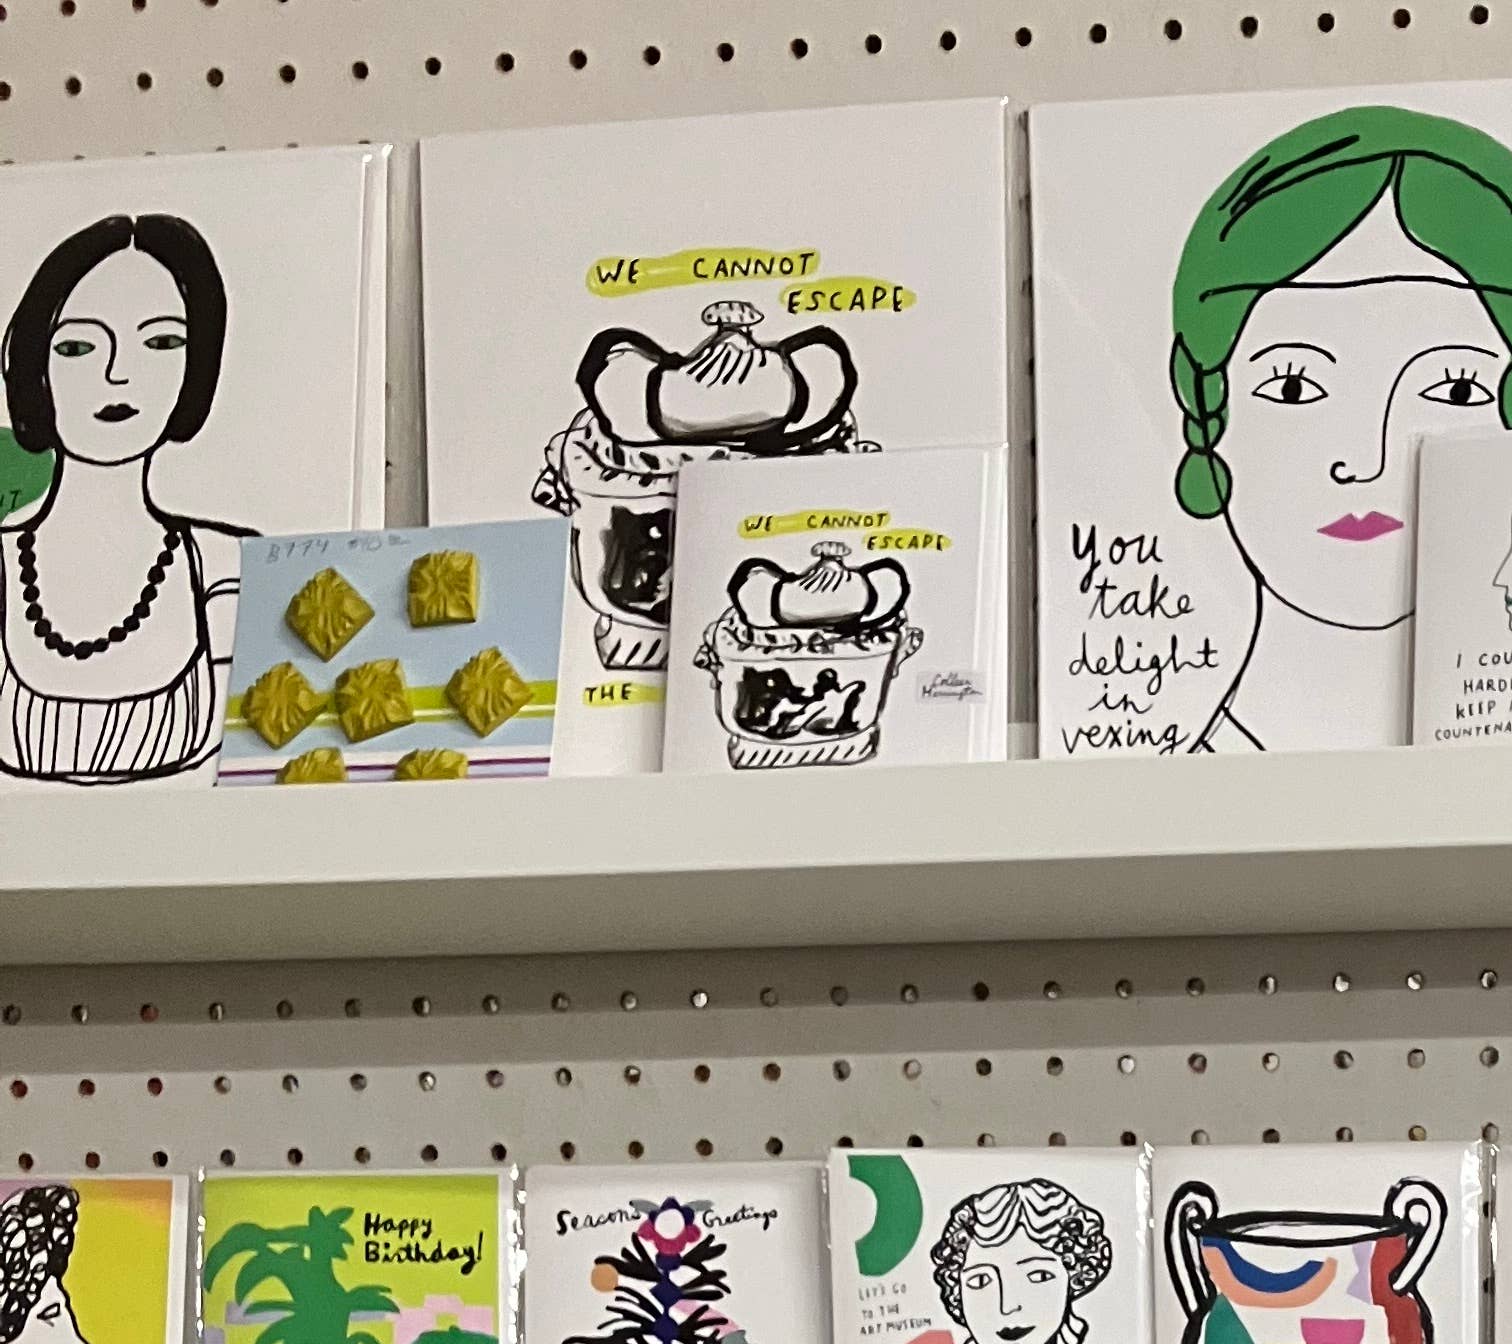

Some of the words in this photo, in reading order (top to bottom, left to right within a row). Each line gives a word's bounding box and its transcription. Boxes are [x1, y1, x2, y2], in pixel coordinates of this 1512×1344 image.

[596, 257, 641, 285] WE
[692, 252, 815, 280] CANNOT
[787, 285, 905, 316] ESCAPE
[743, 514, 775, 533] WE
[806, 512, 889, 529] CANNOT
[866, 534, 945, 552] ESCAPE
[1087, 573, 1196, 620] take
[1068, 631, 1220, 696] delight
[1456, 651, 1462, 669] I
[585, 683, 632, 702] THE
[1087, 682, 1153, 715] in
[1061, 719, 1192, 756] vexing
[363, 1211, 433, 1238] Happy
[701, 1204, 779, 1232] Greetings
[363, 1231, 484, 1275] Birthday!
[860, 1323, 882, 1335] ART
[886, 1318, 933, 1333] MUSEUM
